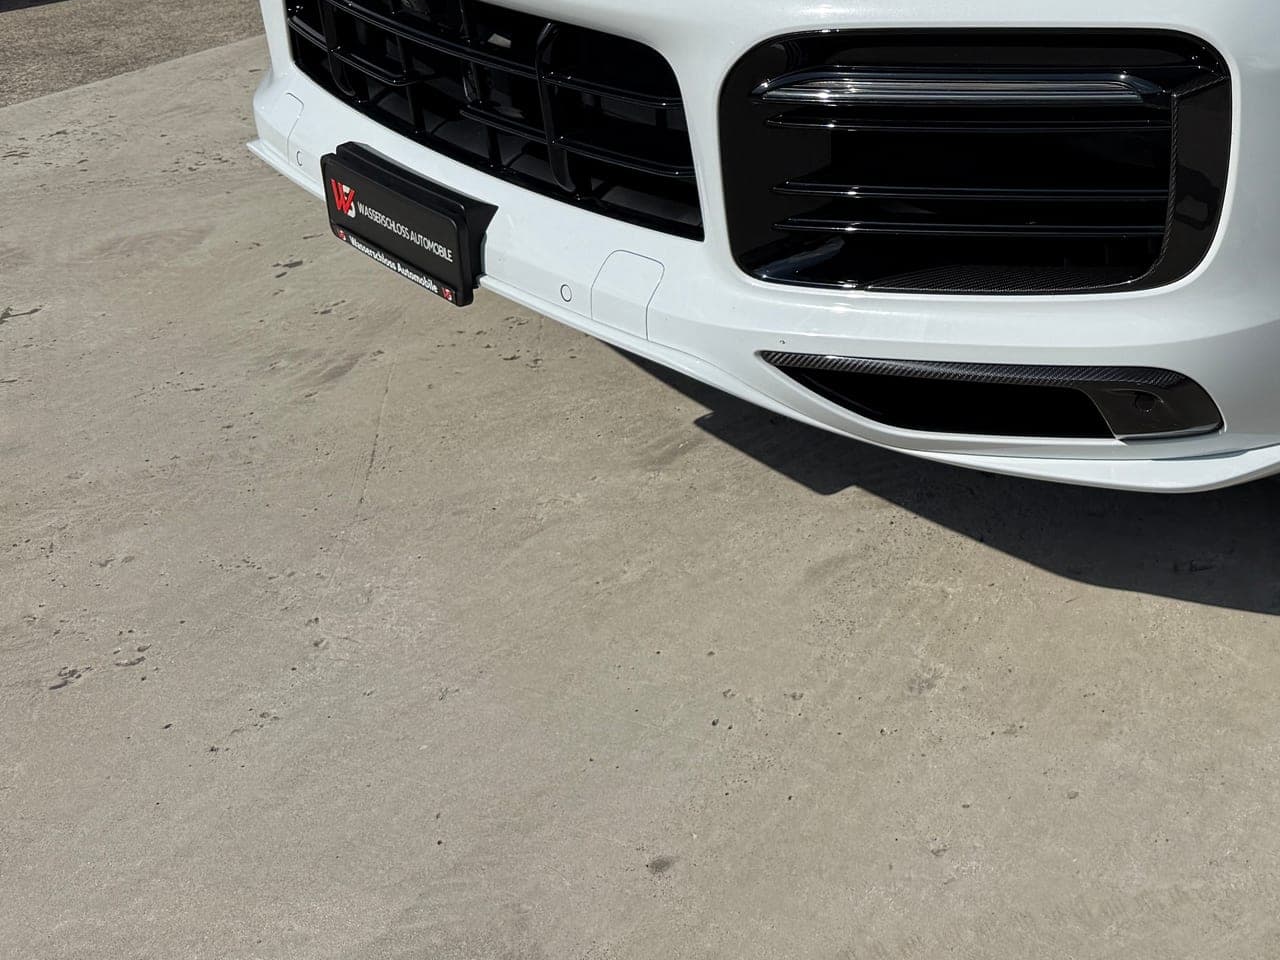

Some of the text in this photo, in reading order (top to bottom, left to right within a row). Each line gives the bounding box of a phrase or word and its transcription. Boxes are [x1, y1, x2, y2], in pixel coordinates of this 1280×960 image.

[357, 201, 453, 263] WASSERSCHLOSS AUTOMOBILE
[349, 235, 439, 294] Wasserschloss Automobile
